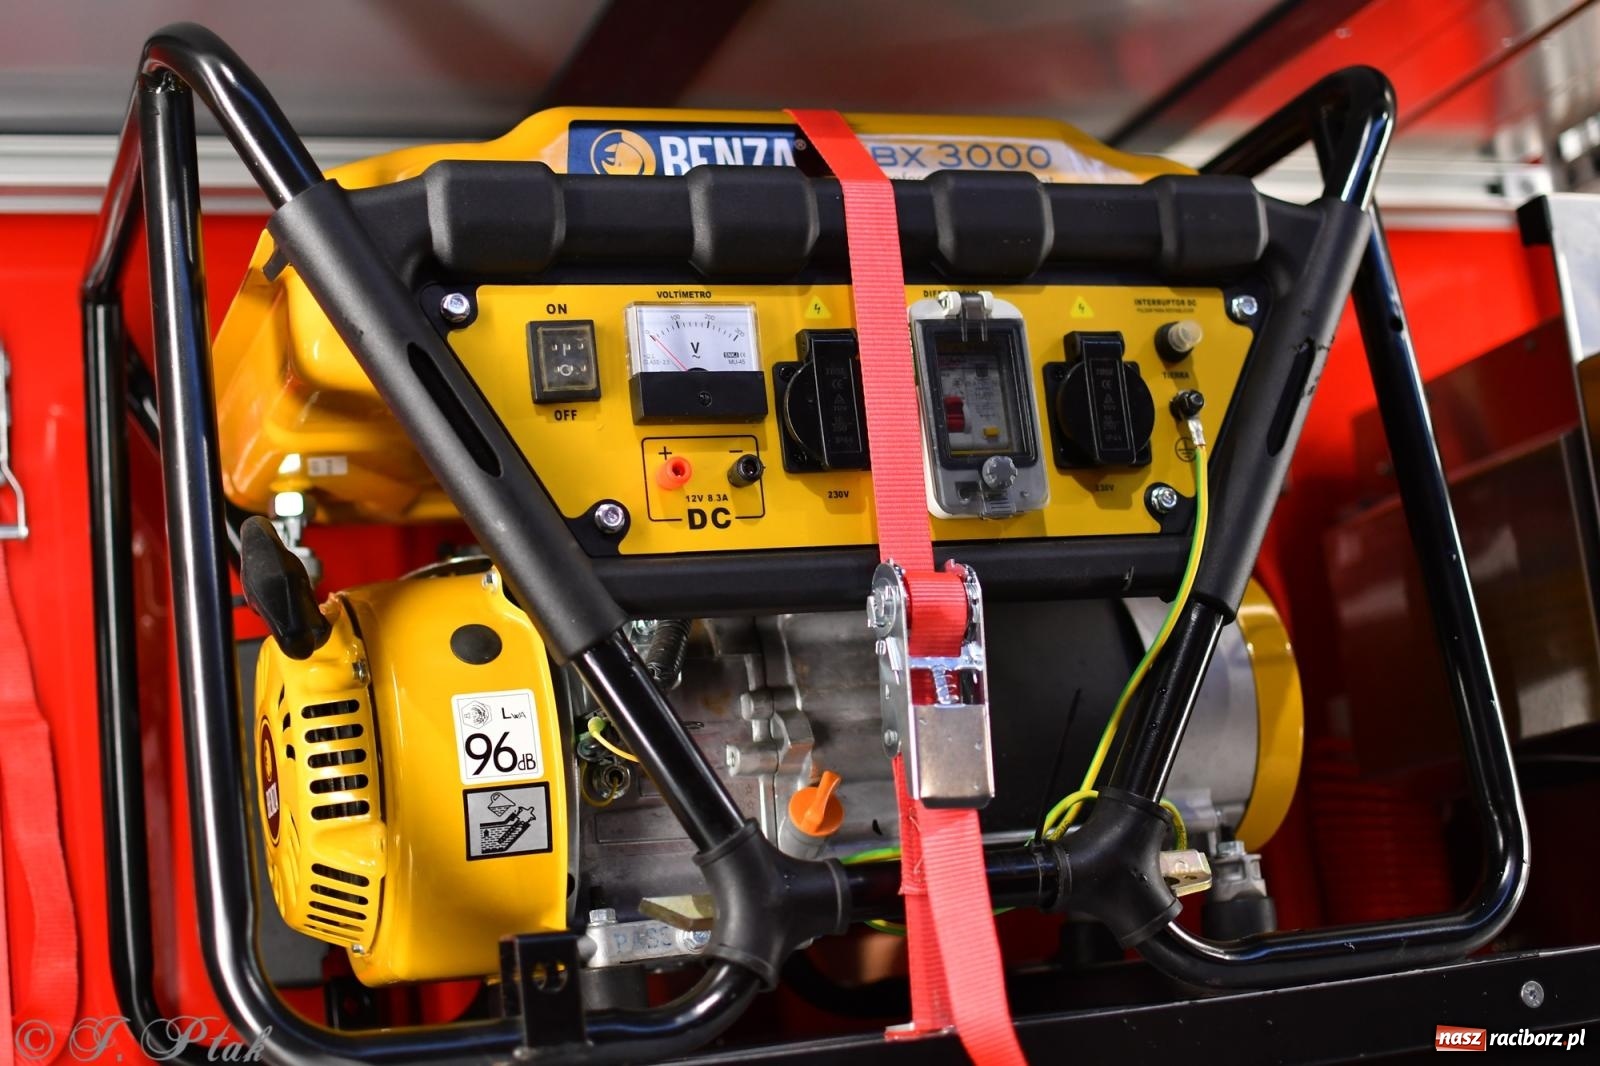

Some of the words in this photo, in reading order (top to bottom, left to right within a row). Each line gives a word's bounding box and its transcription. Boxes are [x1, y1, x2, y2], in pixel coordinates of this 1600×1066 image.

[937, 143, 1052, 169] 3000
[546, 304, 568, 314] ON
[690, 342, 701, 354] V
[554, 410, 578, 421] OFF
[685, 494, 704, 503] 12V
[827, 490, 850, 499] 230V
[687, 506, 732, 530] DC
